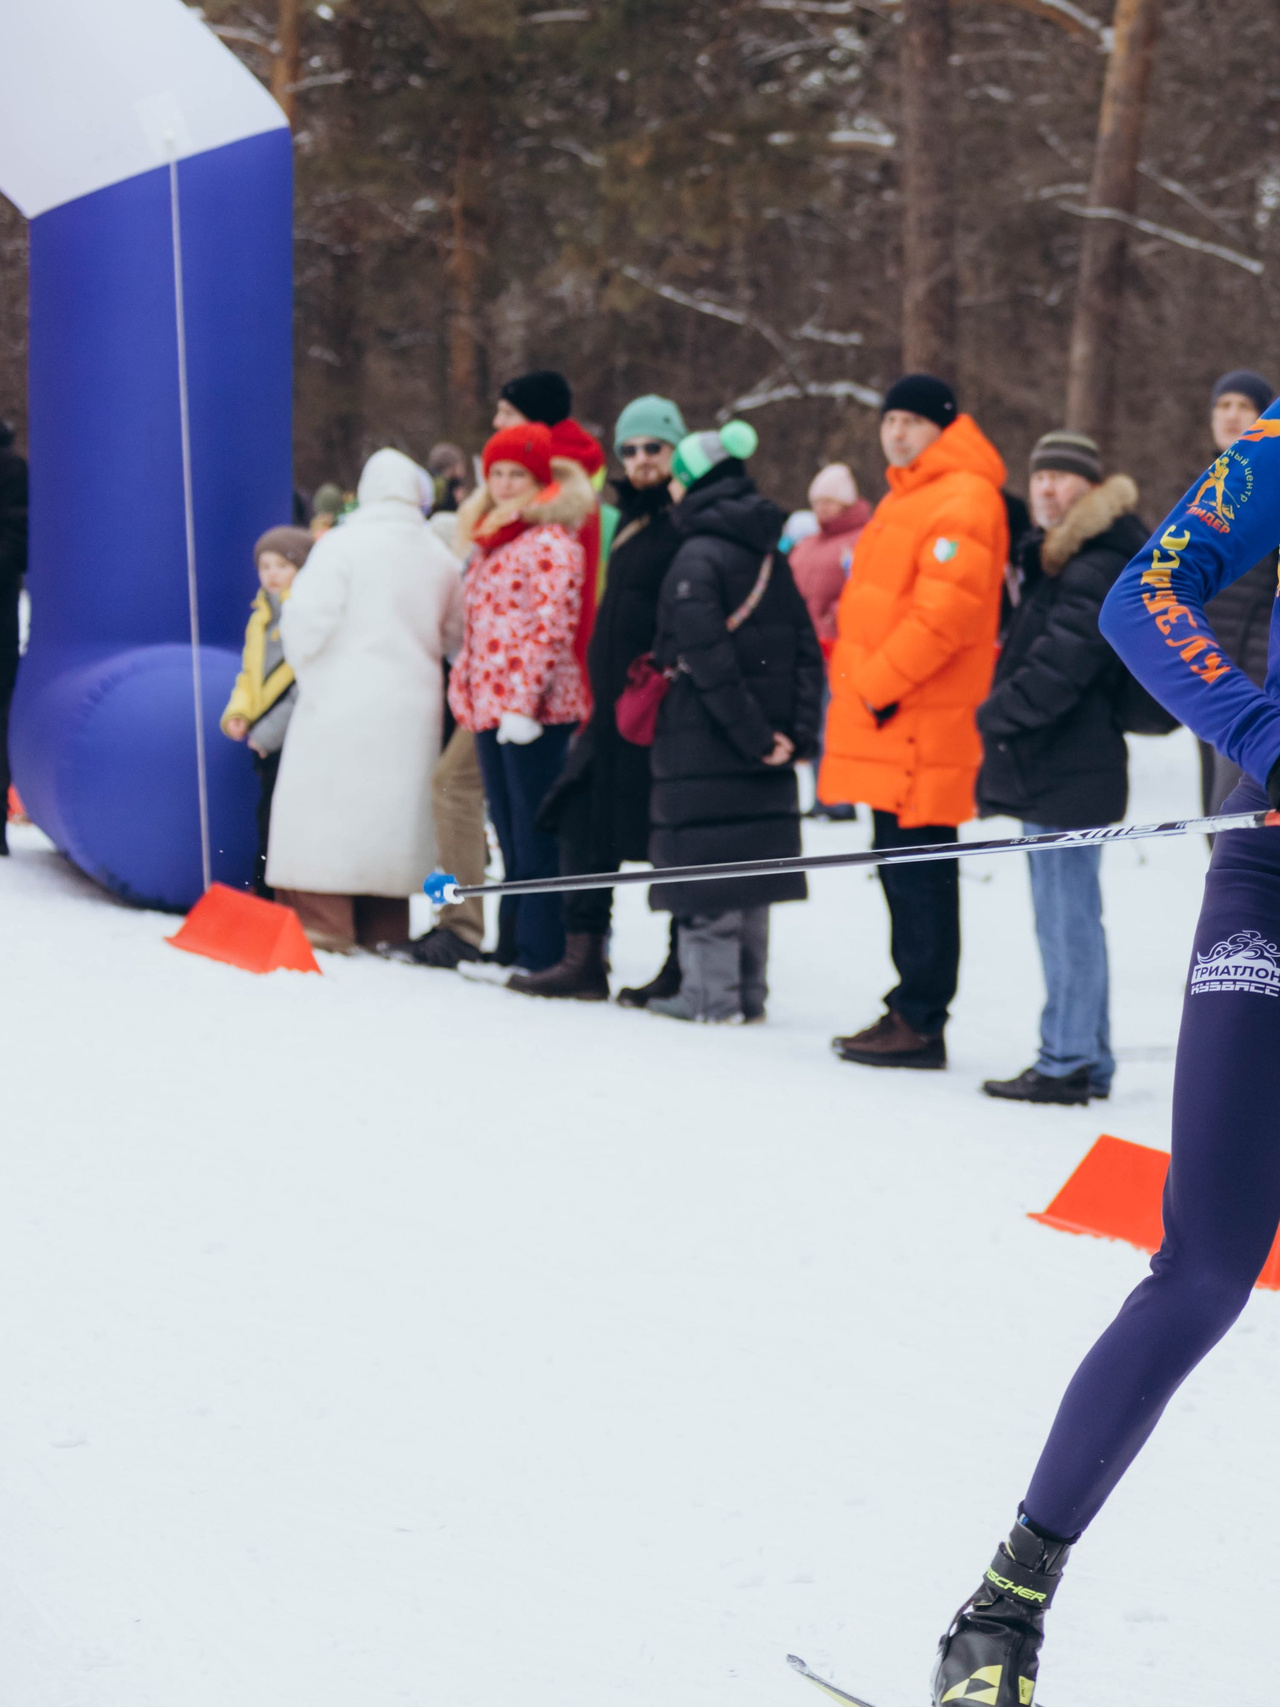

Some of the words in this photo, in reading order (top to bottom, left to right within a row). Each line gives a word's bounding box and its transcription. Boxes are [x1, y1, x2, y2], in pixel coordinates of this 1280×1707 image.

[1185, 506, 1231, 534] ЛИДЕР
[1141, 525, 1231, 685] КУЗБАСС
[1190, 981, 1280, 998] КУЗБАСС
[987, 1566, 1047, 1603] ISCHER
